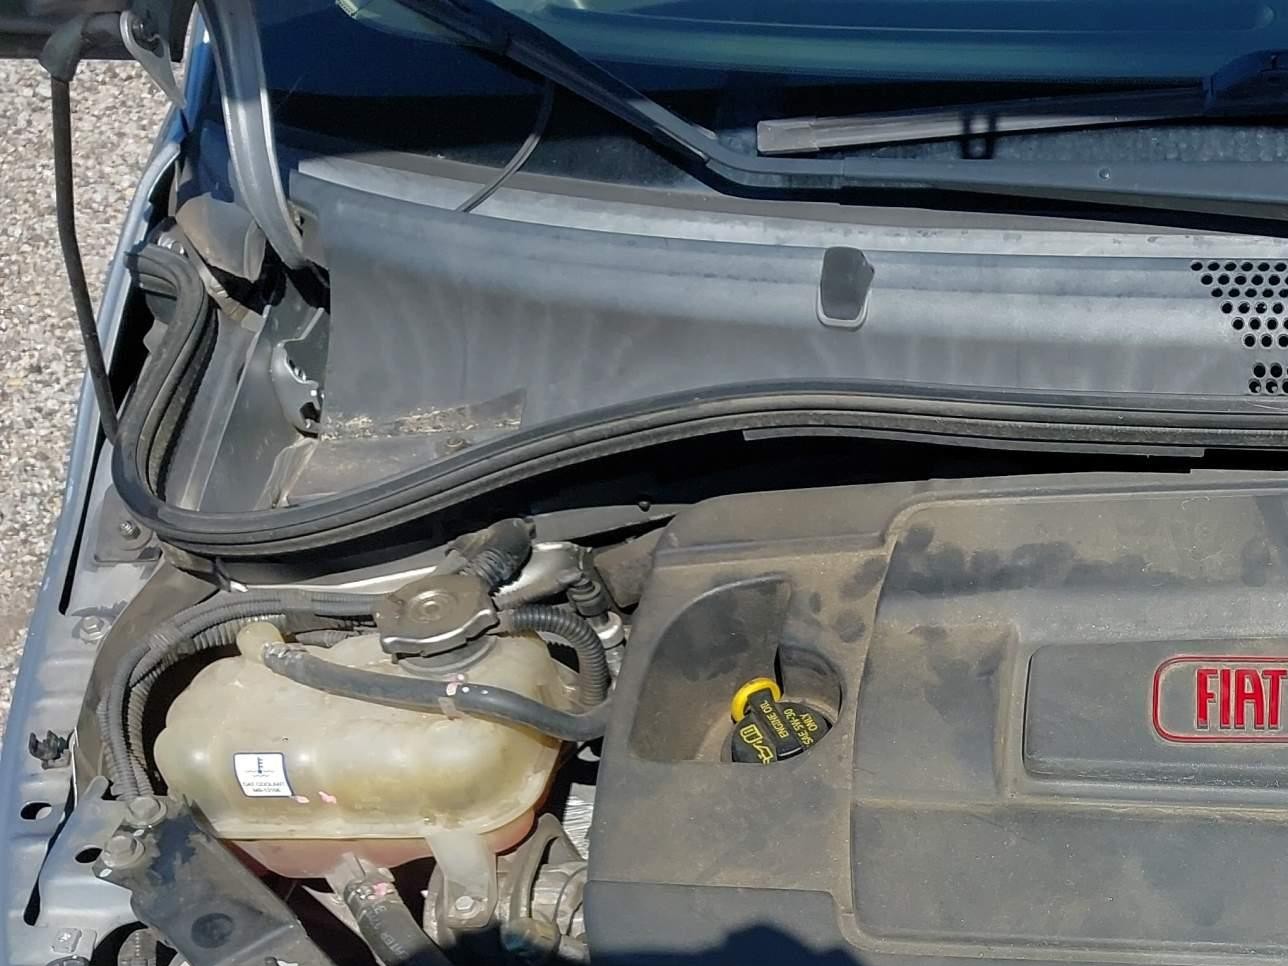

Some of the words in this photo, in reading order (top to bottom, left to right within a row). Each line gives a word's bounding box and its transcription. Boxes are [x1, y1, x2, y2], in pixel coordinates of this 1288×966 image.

[760, 699, 773, 713] OIL
[1196, 669, 1288, 730] FIAT
[766, 712, 790, 739] ENGINE
[783, 708, 804, 731] 5W-30
[799, 712, 818, 731] ONLY
[796, 730, 814, 745] SAE
